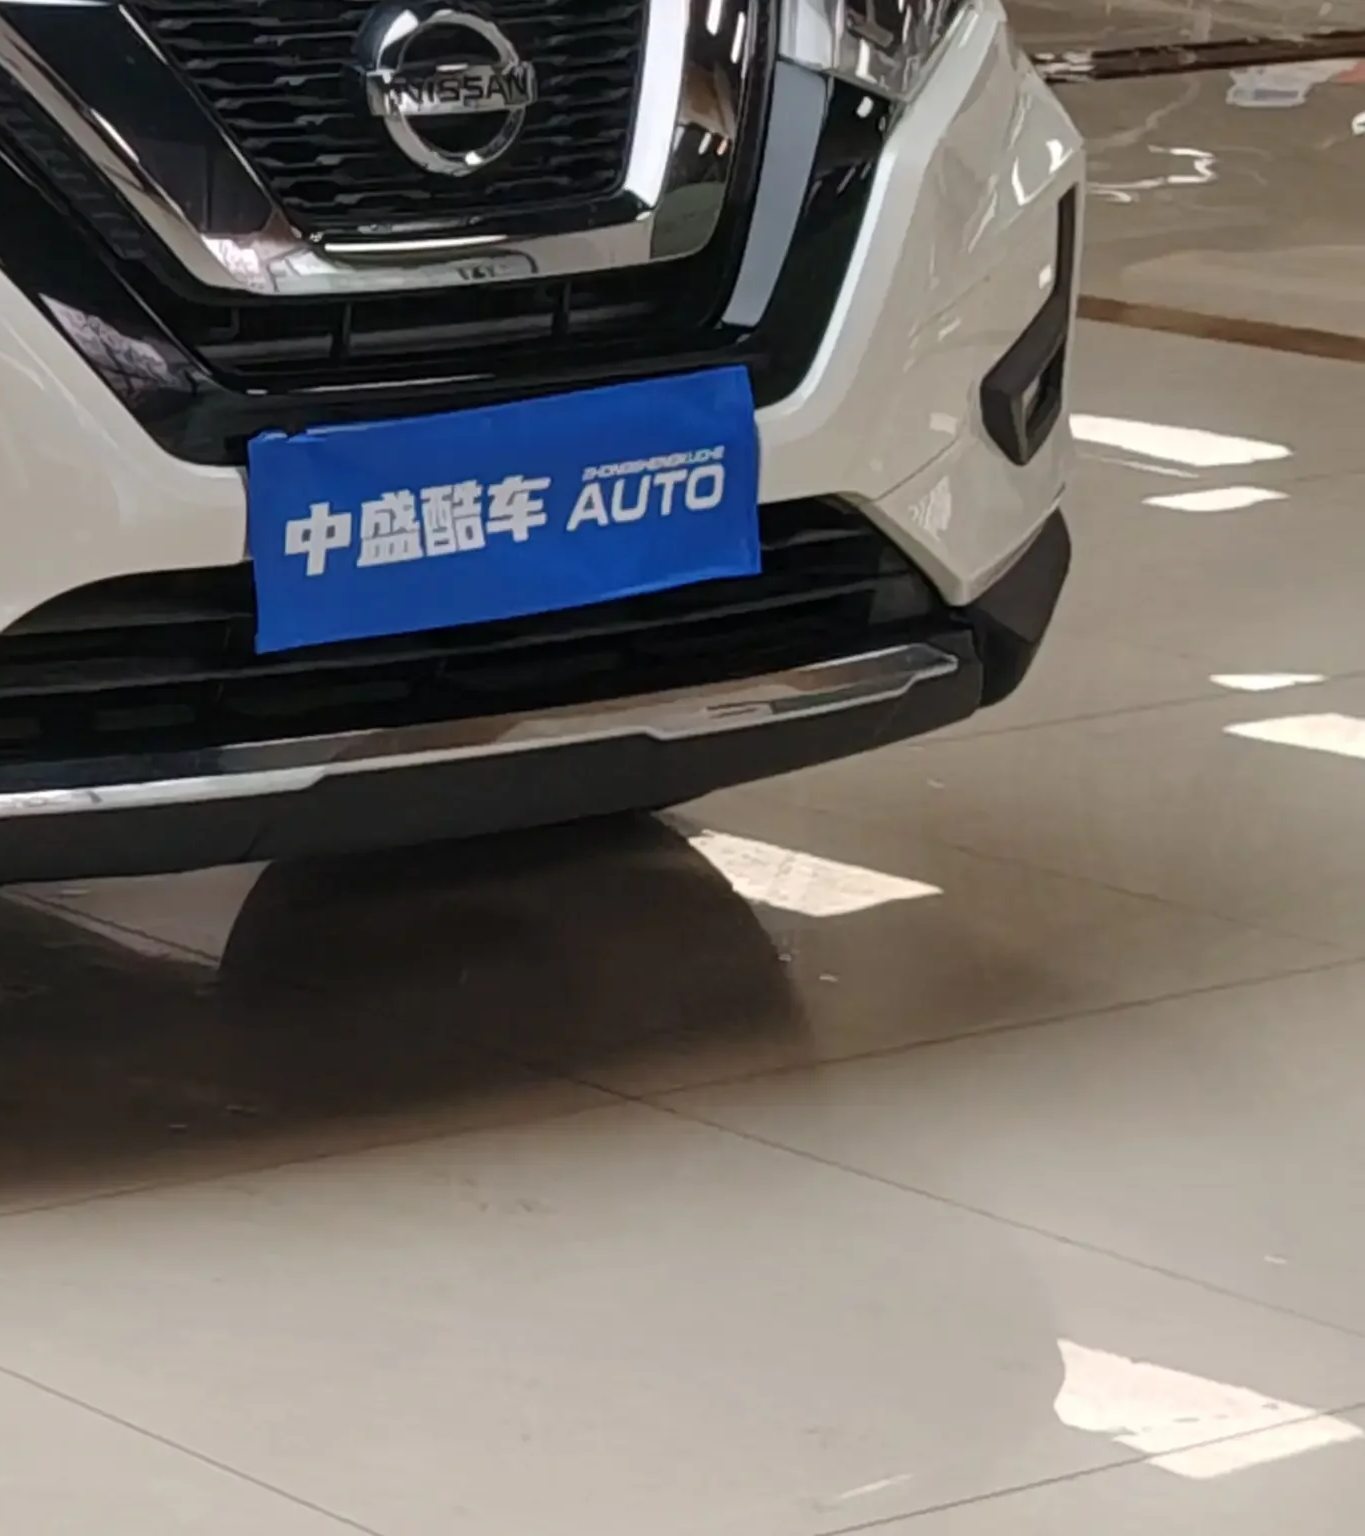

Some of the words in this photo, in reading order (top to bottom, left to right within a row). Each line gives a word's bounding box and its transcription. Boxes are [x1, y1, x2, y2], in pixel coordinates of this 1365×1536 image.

[390, 73, 527, 111] NISSAN
[284, 474, 551, 577] 中盛酷车
[566, 463, 725, 532] AUTO
